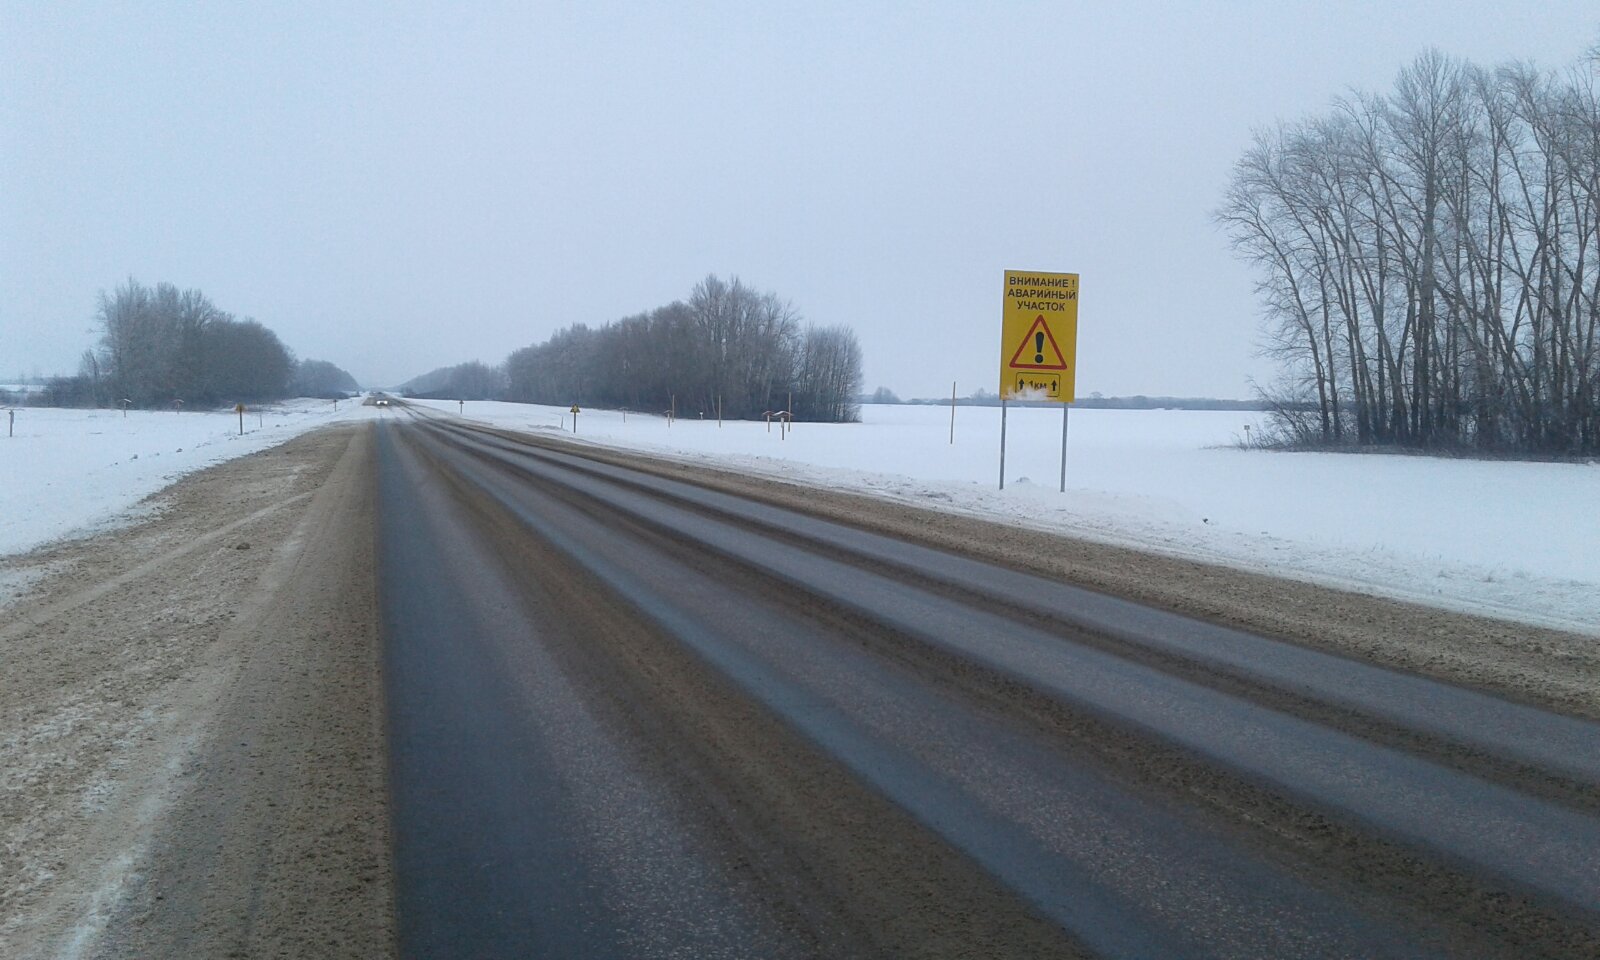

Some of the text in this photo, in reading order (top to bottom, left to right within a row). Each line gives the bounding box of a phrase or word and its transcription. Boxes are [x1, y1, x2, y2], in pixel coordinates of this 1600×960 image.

[1009, 276, 1069, 288] ВНИМАНИЕ
[1007, 288, 1076, 300] АВАРИЙНЫЙ
[1017, 300, 1066, 312] УЧАСТОК
